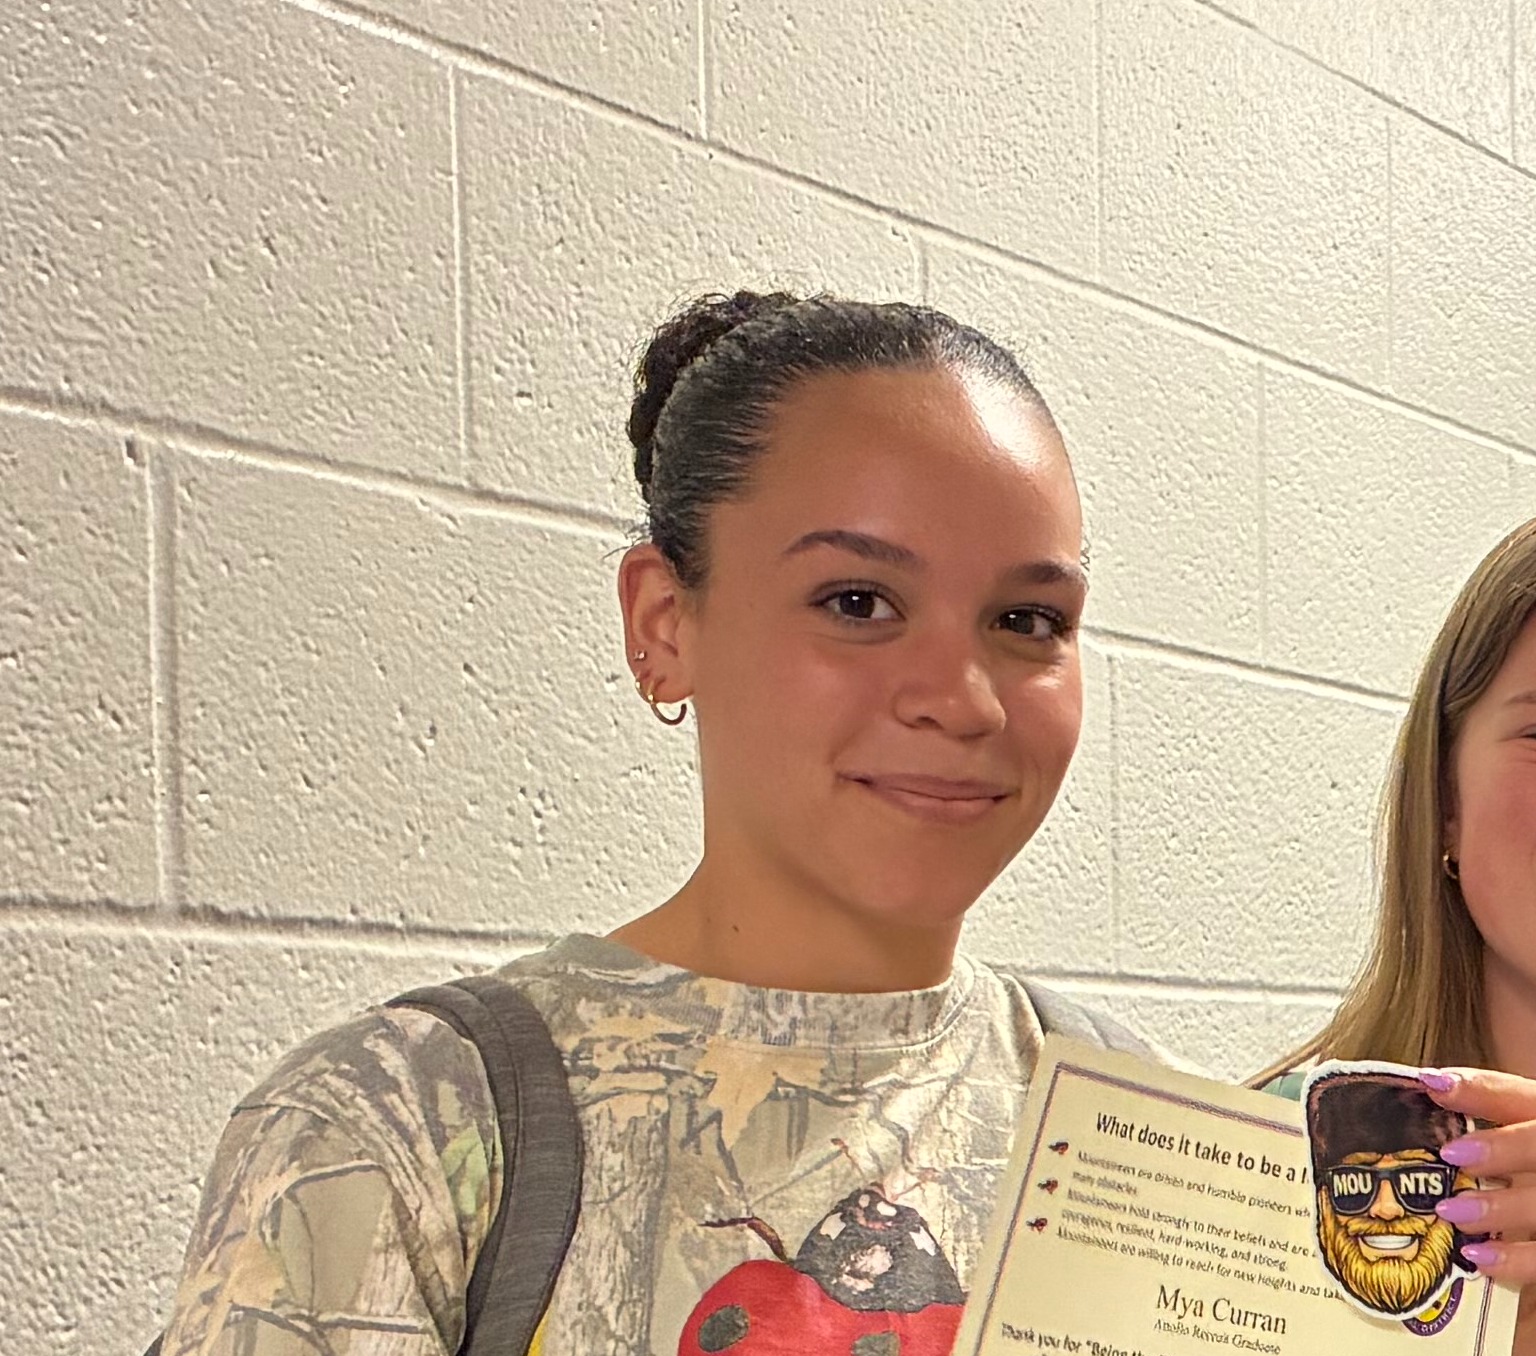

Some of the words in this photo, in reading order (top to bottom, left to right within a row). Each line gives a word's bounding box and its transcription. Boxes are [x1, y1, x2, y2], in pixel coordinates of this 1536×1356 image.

[1096, 1112, 1134, 1142] What
[1138, 1126, 1174, 1151] does
[1179, 1136, 1190, 1156] it
[1195, 1141, 1231, 1166] take
[1237, 1151, 1254, 1170] to
[1261, 1156, 1281, 1178] be
[1286, 1168, 1296, 1182] a
[1333, 1172, 1372, 1197] MOU
[1400, 1172, 1443, 1195] NTS
[1156, 1284, 1204, 1319] Mya
[1212, 1298, 1287, 1334] Curran
[1064, 1335, 1082, 1351] for
